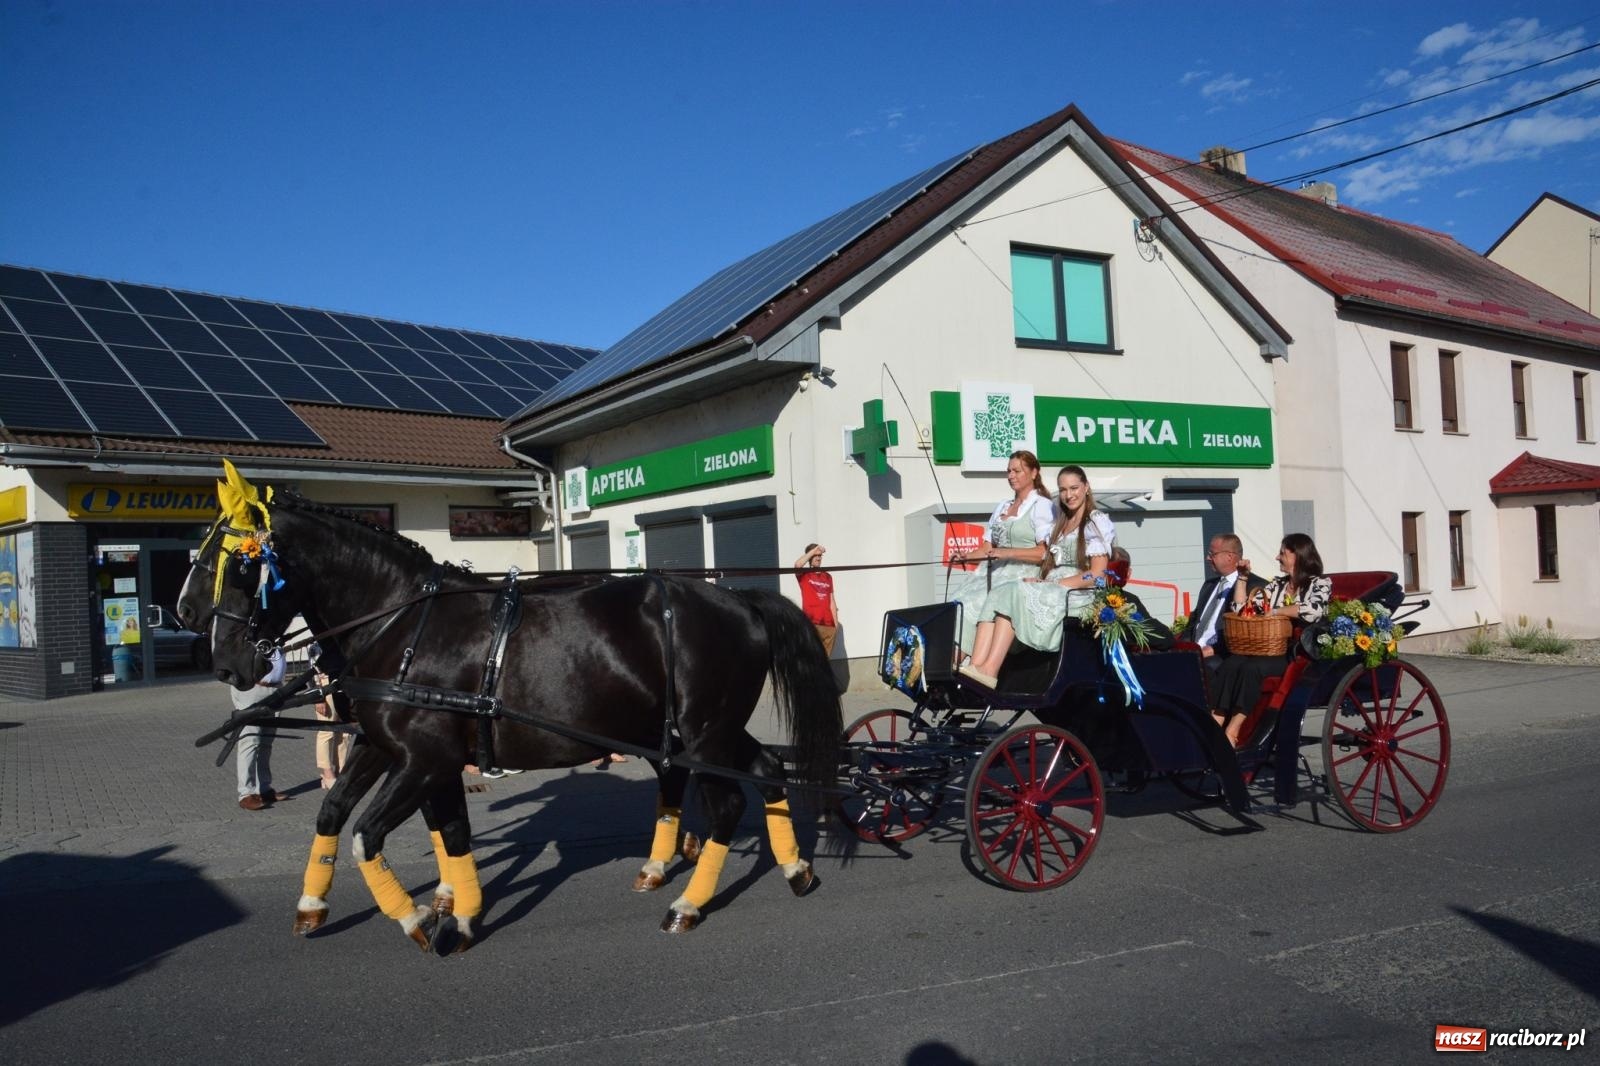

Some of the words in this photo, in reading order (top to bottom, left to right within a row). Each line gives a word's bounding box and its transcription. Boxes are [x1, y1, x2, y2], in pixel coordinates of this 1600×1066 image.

[1051, 415, 1178, 446] APTEKA
[1202, 433, 1262, 449] ZIELONA
[591, 465, 645, 496] APTEKA
[703, 447, 758, 473] ZIELONA
[126, 491, 217, 509] LEWIATA
[947, 536, 979, 547] ORLEN
